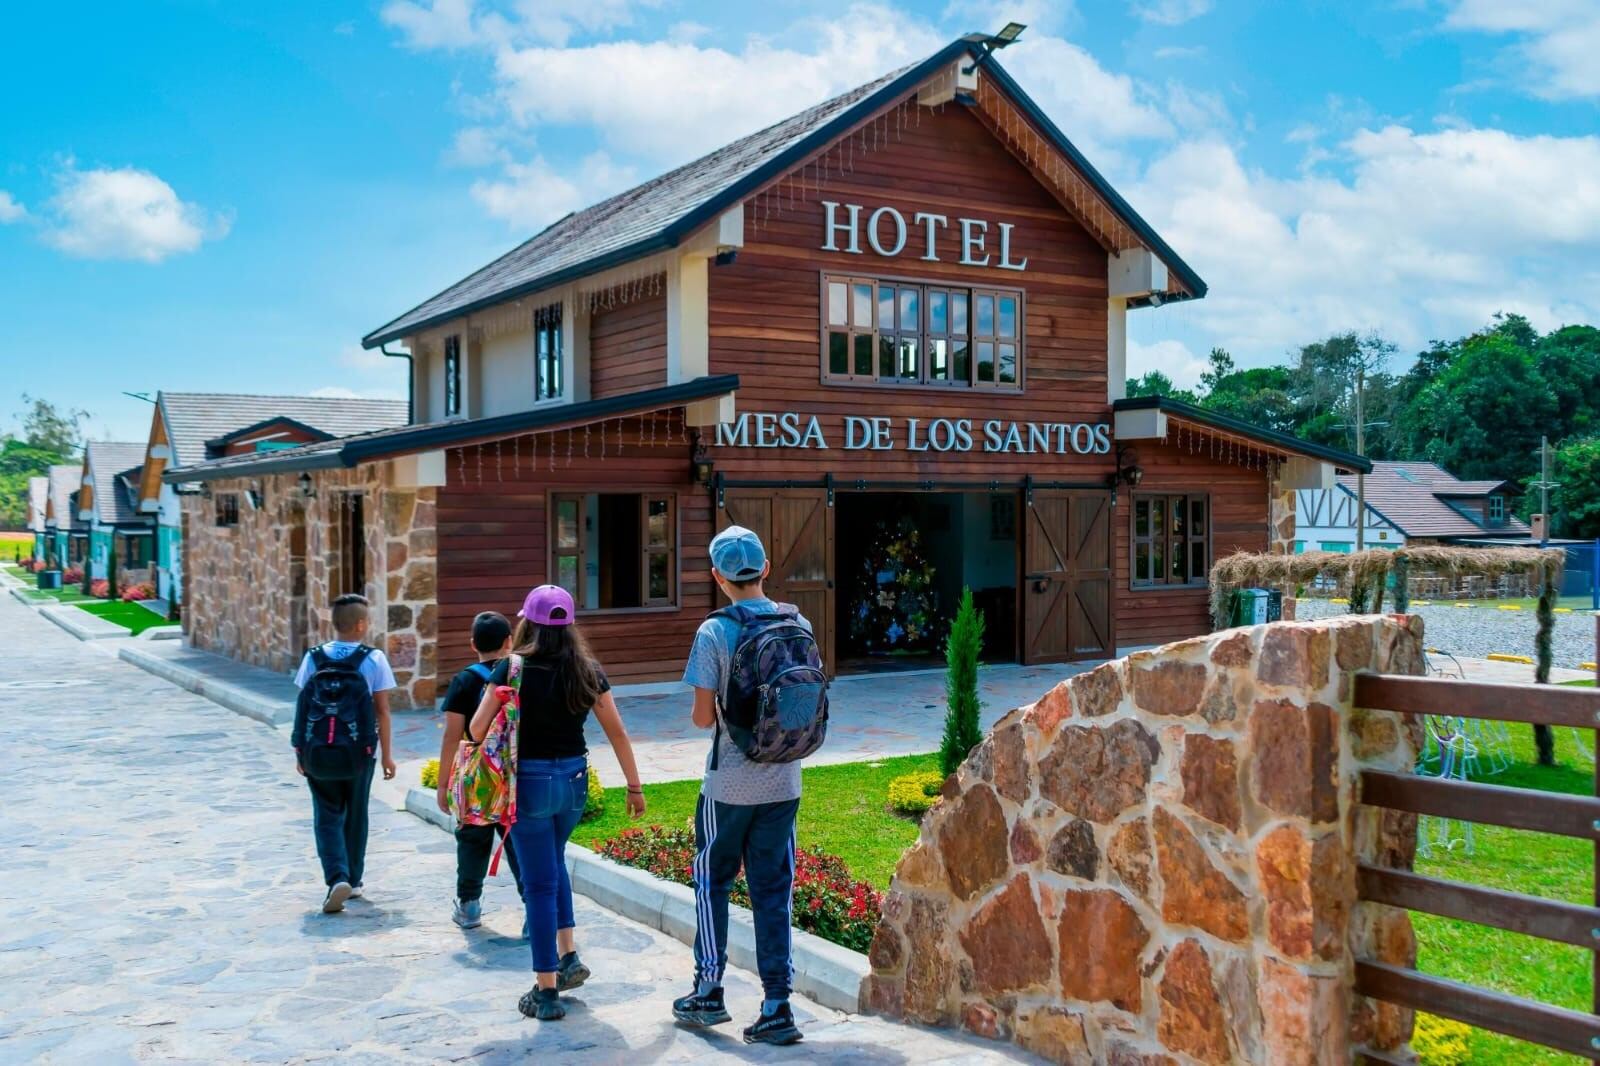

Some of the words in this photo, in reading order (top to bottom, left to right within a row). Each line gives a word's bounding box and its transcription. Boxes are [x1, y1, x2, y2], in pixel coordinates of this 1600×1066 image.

[820, 200, 1029, 272] HOTEL
[714, 412, 829, 449] MESA
[844, 416, 894, 451] DE
[907, 417, 974, 453] LOS
[983, 419, 1111, 455] SANTOS
